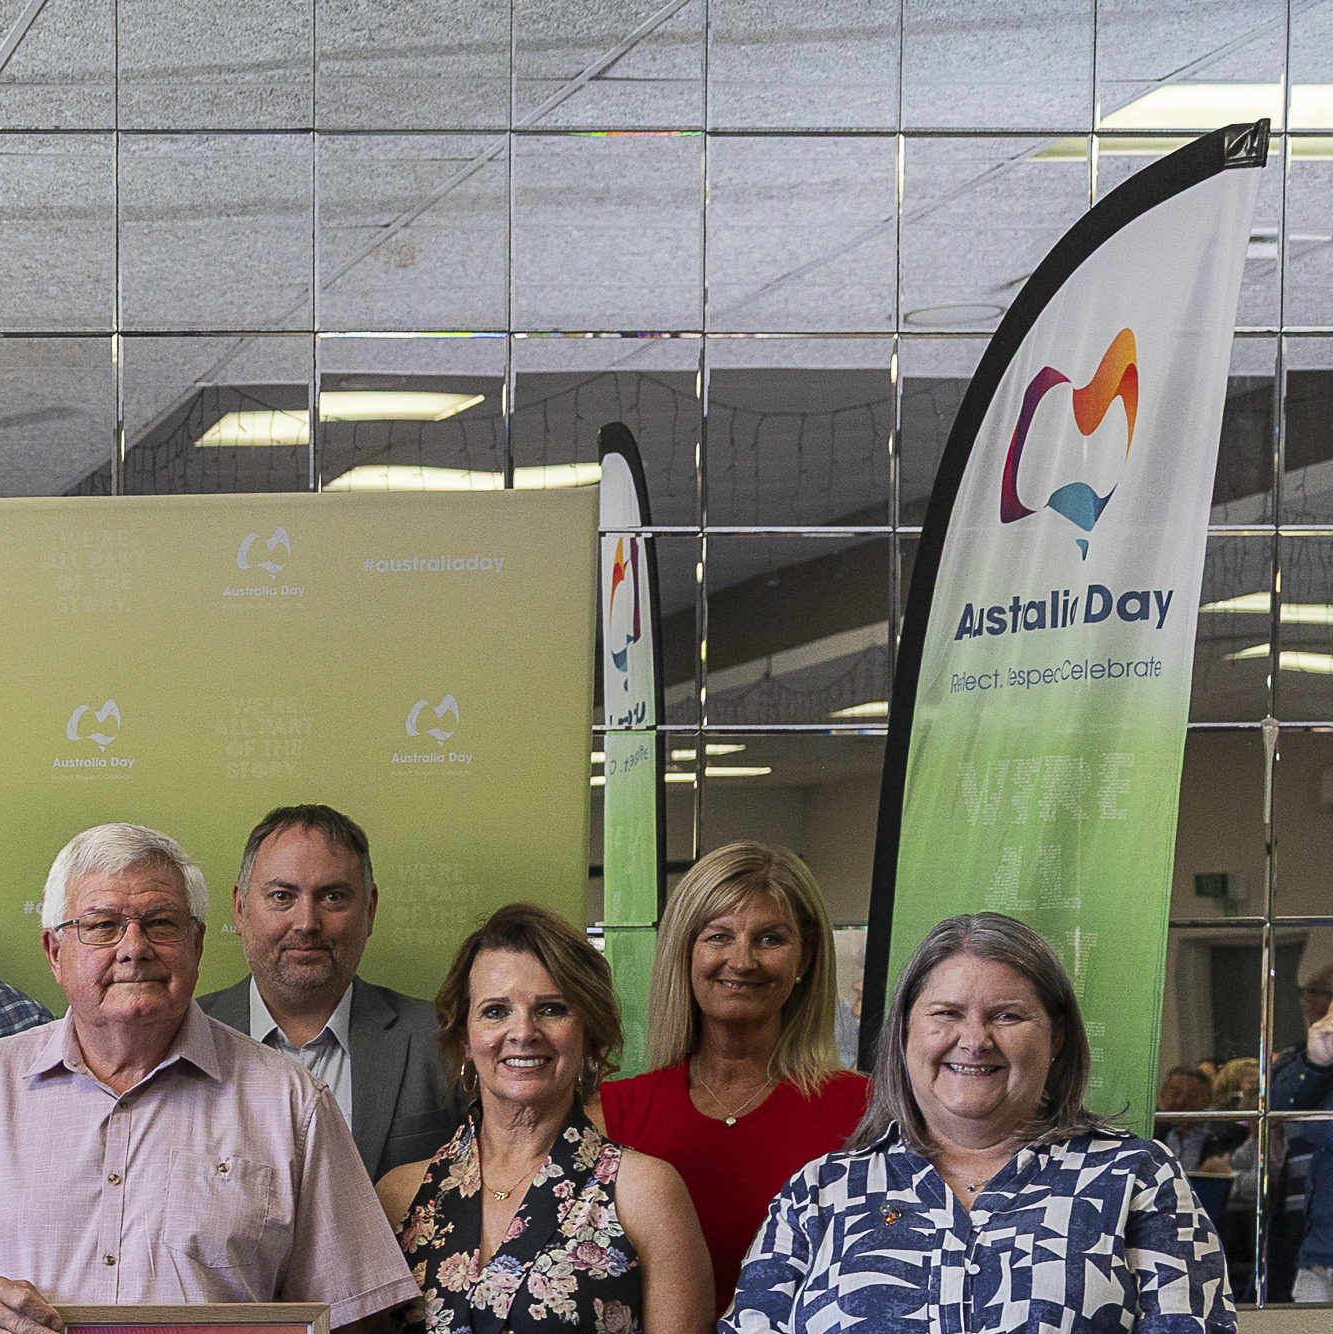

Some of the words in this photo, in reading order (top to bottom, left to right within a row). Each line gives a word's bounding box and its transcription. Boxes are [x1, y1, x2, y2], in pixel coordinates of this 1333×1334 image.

[363, 554, 505, 574] #australiaday
[223, 585, 276, 597] Australia
[280, 585, 305, 599] Day
[1083, 584, 1174, 630] Day
[1061, 656, 1162, 681] Celebrate
[53, 757, 107, 768] Australia
[110, 757, 135, 771] Day
[391, 752, 444, 763] Australia
[448, 752, 473, 766] Day
